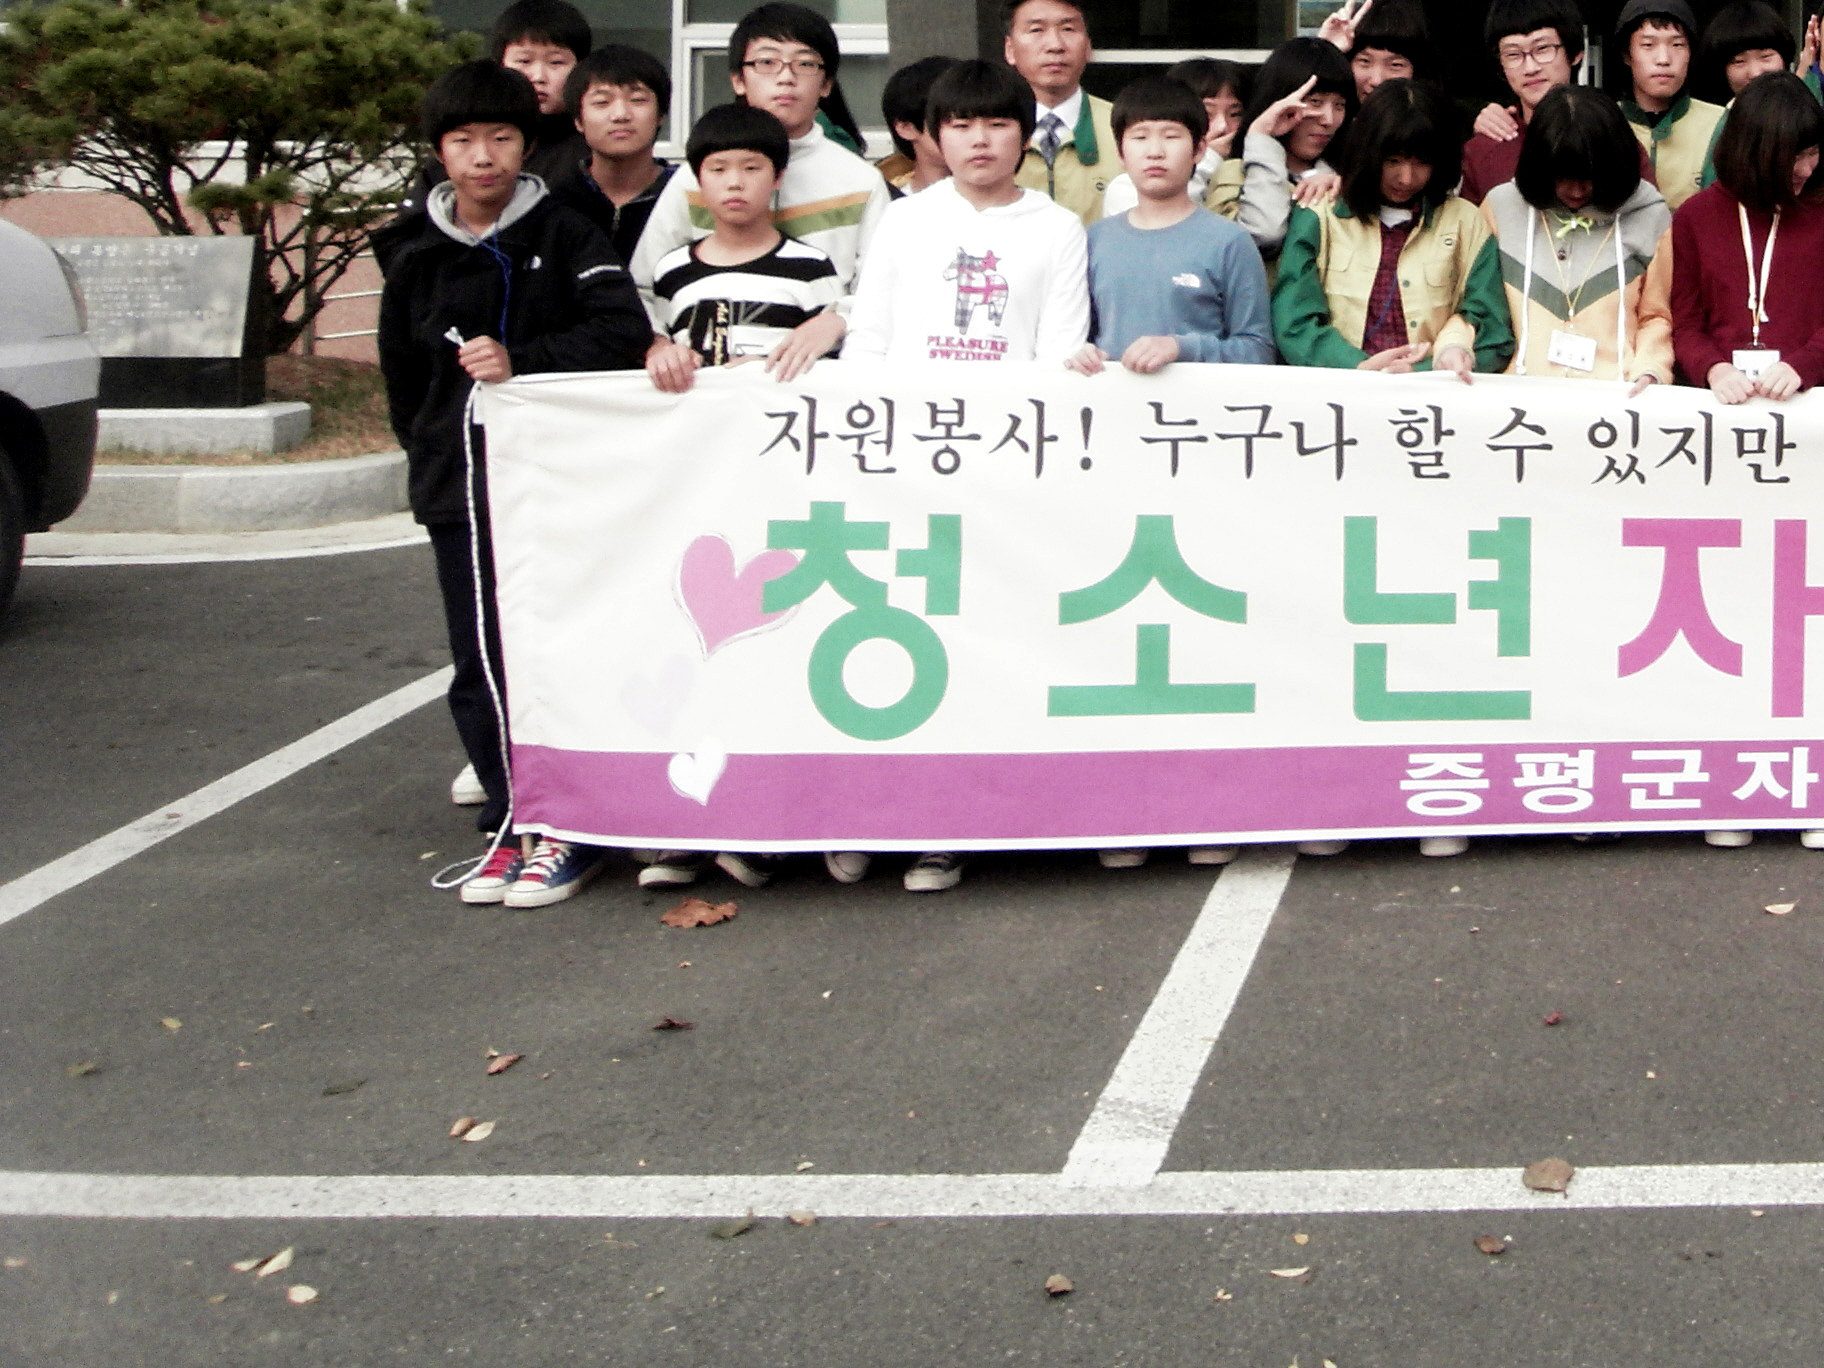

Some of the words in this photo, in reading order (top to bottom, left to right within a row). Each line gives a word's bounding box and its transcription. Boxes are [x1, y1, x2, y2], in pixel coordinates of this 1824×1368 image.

[926, 335, 1008, 354] PLEASURE
[759, 394, 1094, 479] 자원봉사!
[1138, 400, 1358, 482] 누구나
[1388, 403, 1456, 481] 할
[1485, 406, 1553, 483] 수
[1586, 409, 1797, 486] 있지만
